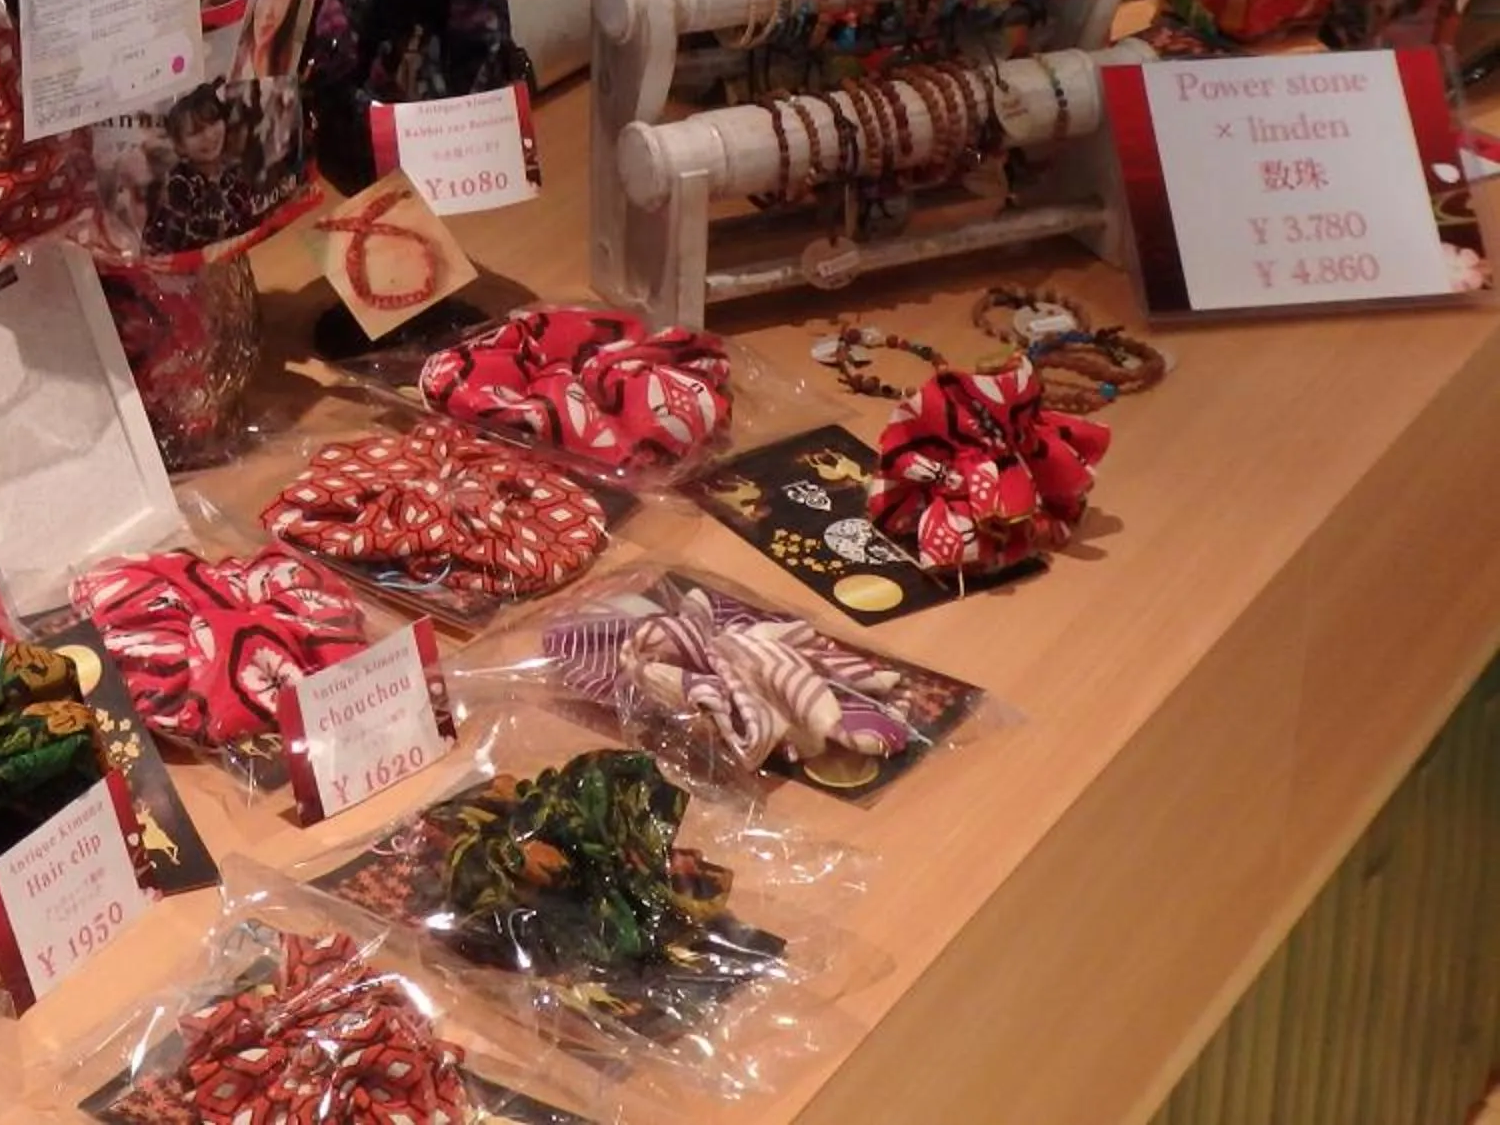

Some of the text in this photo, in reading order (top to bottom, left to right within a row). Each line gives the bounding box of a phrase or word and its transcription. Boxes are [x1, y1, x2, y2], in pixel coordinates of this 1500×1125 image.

[1175, 70, 1368, 102] Power stone
[1248, 114, 1350, 144] linden
[1261, 158, 1330, 193] 数珠
[318, 674, 411, 733] chouchou
[364, 746, 424, 793] 1620
[25, 859, 66, 898] Hair
[70, 833, 102, 866] clip
[68, 901, 124, 959] 1950
